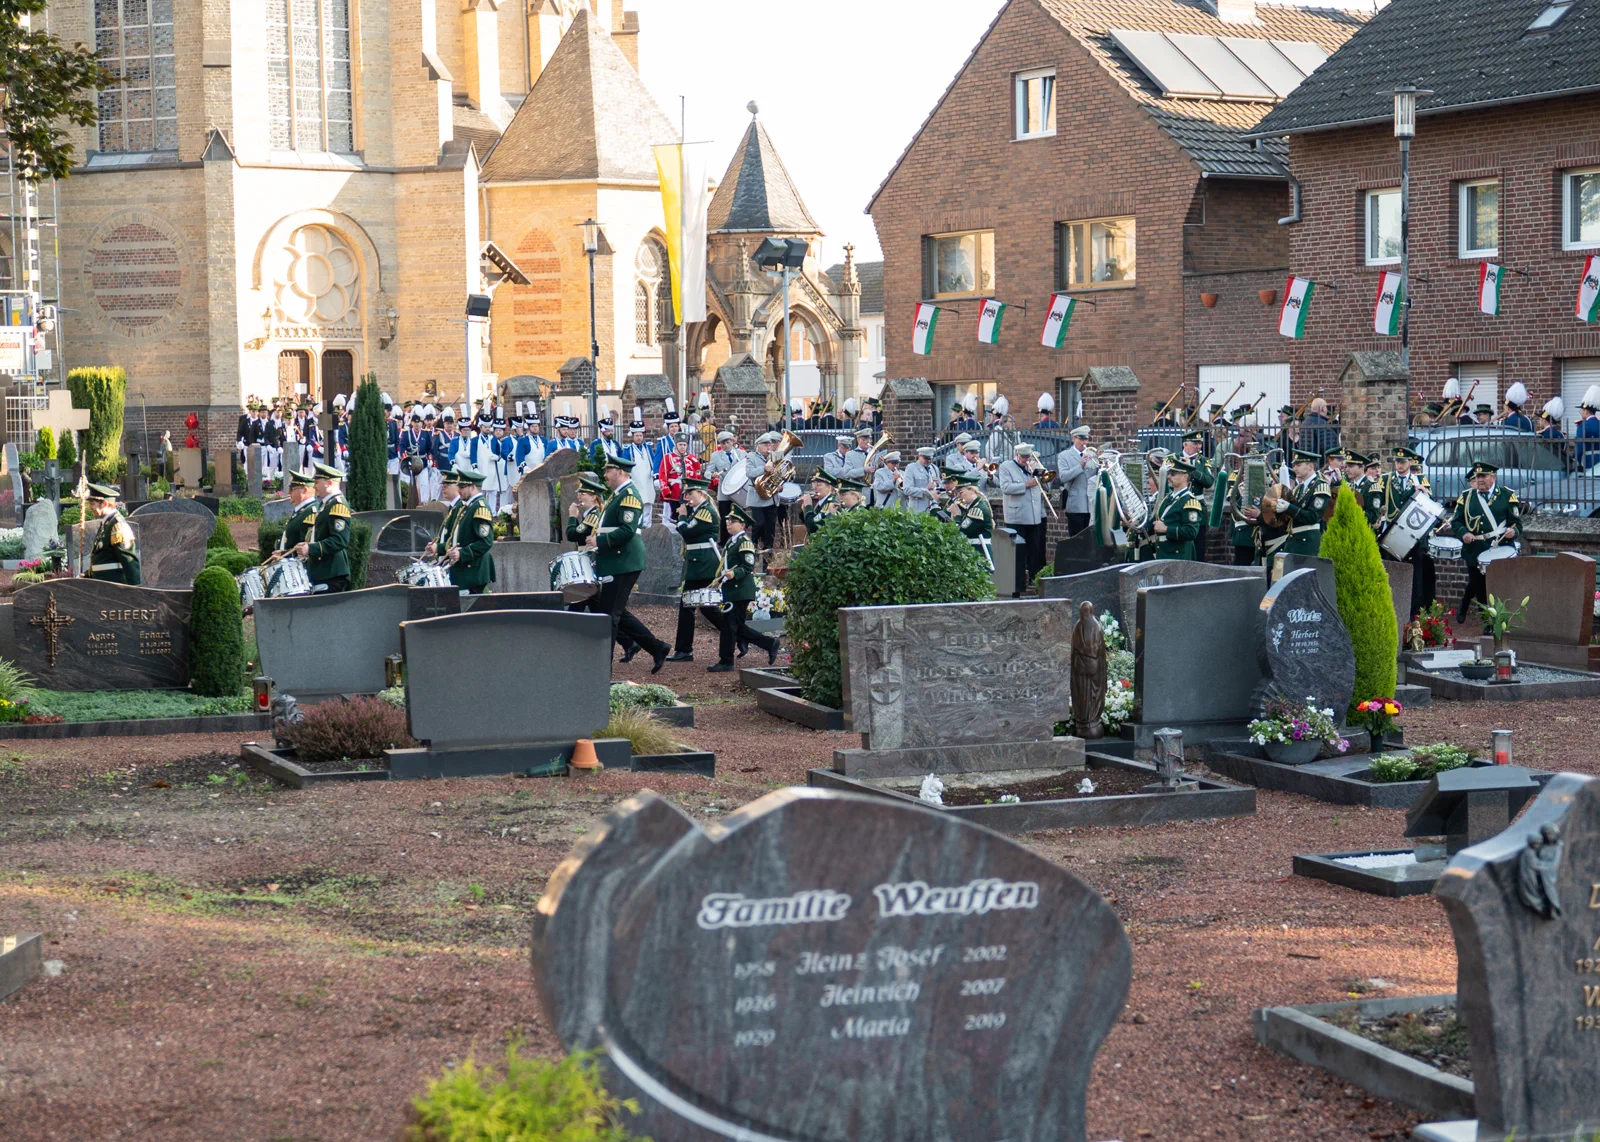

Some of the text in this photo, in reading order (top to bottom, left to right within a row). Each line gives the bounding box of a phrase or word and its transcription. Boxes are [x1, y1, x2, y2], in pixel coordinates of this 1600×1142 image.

[100, 609, 157, 620] SEIFERT
[88, 631, 115, 641] Agnes
[139, 630, 171, 639] Erhard
[1291, 630, 1320, 639] Herbert
[697, 878, 1039, 929] Familie Weuffen
[796, 951, 867, 975] Heinz
[876, 944, 945, 971] Josef
[962, 944, 1007, 963] 2002
[819, 980, 921, 1008] Heinrich
[959, 977, 1006, 996] 2007
[735, 1028, 776, 1047] 1929
[830, 1015, 911, 1040] Maria
